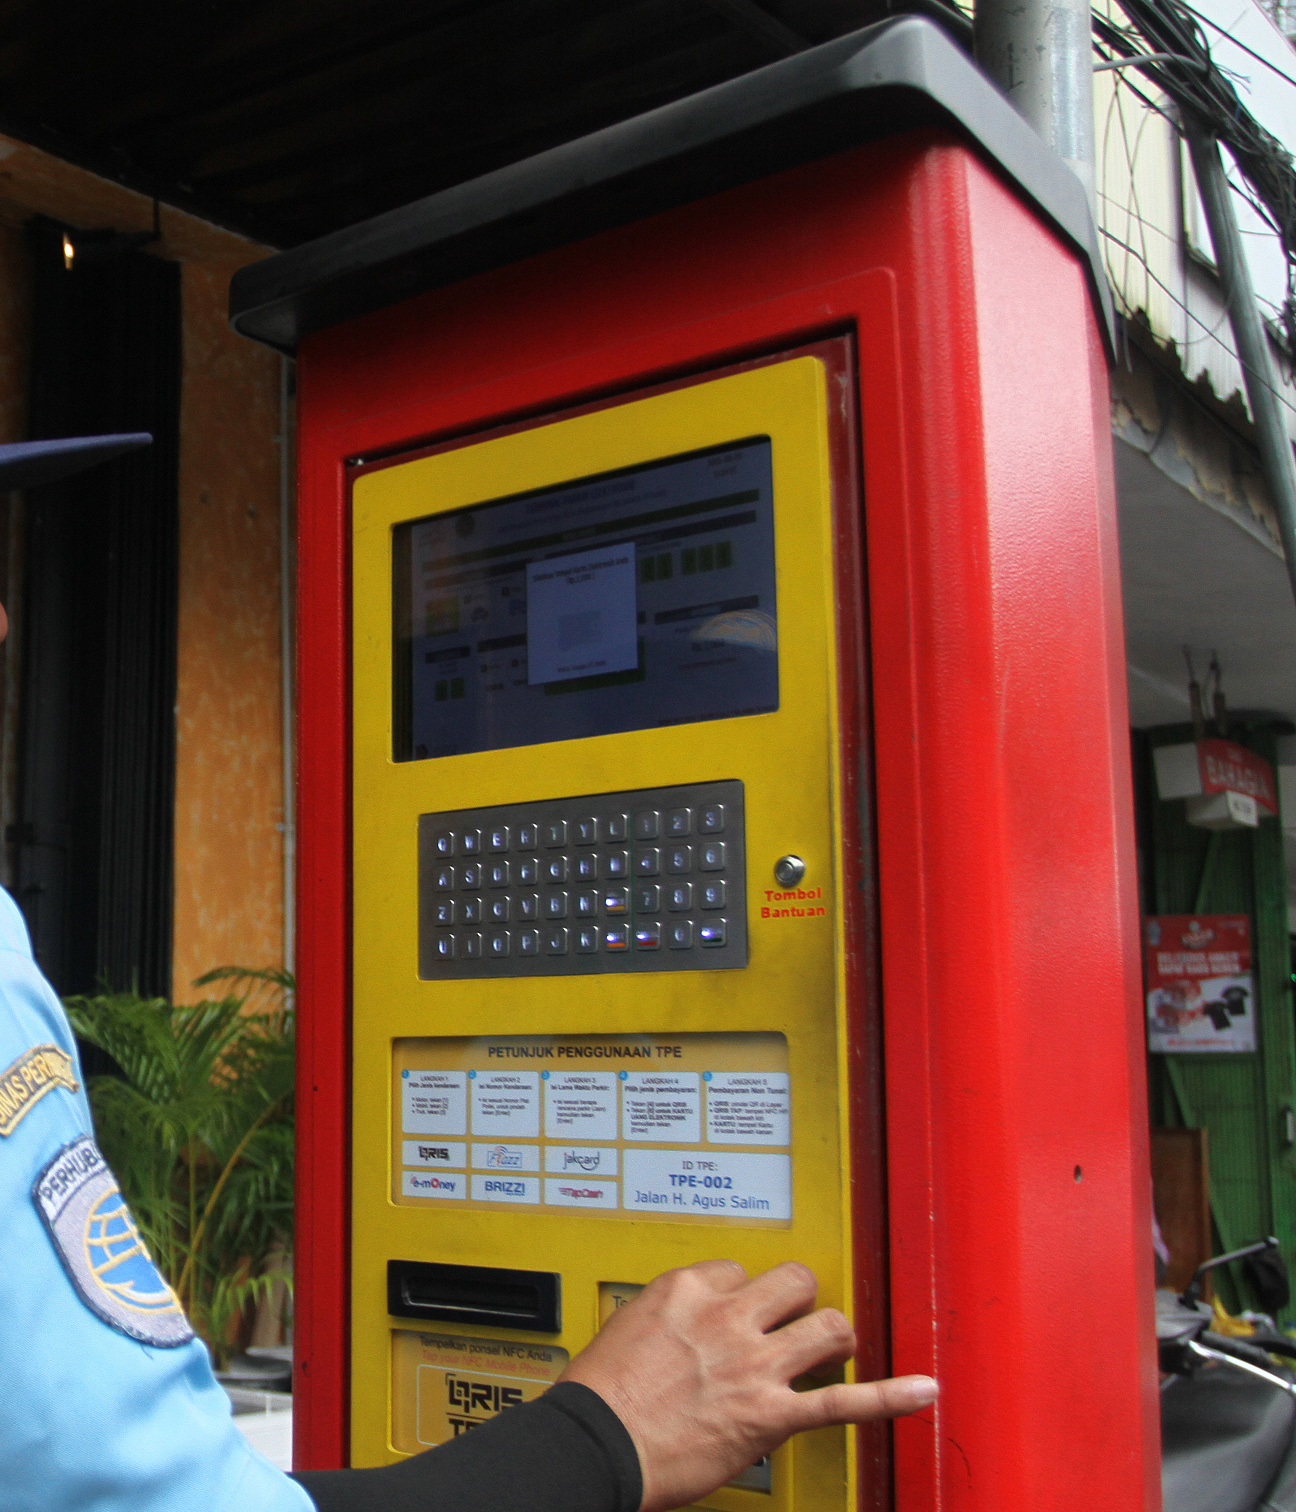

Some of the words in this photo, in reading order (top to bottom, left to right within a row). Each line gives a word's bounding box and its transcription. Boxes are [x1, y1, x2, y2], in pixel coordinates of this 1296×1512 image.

[764, 887, 822, 901] Tombol
[761, 906, 827, 919] Bantuan
[488, 1046, 553, 1059] PETUNJUK
[557, 1046, 651, 1059] PENGGUNAAN
[656, 1046, 682, 1058] TPE
[418, 1146, 450, 1161] QRIS
[562, 1151, 600, 1170] jakcard
[682, 1161, 694, 1170] ID
[695, 1161, 718, 1171] TPE:
[42, 1148, 101, 1206] PERHUB
[669, 1174, 733, 1190] TPE-002
[485, 1181, 525, 1194] BRIZZI
[635, 1190, 668, 1204] Jalan
[672, 1193, 686, 1205] H.
[692, 1193, 726, 1209] Agus
[730, 1196, 770, 1210] Salim
[420, 1335, 467, 1353] Tempelkan
[469, 1344, 502, 1357] ponsel
[503, 1347, 523, 1358] NFC
[527, 1350, 552, 1363] Anda
[462, 1356, 482, 1367] NFC
[520, 1362, 551, 1376] Phone
[447, 1379, 524, 1414] QRIS
